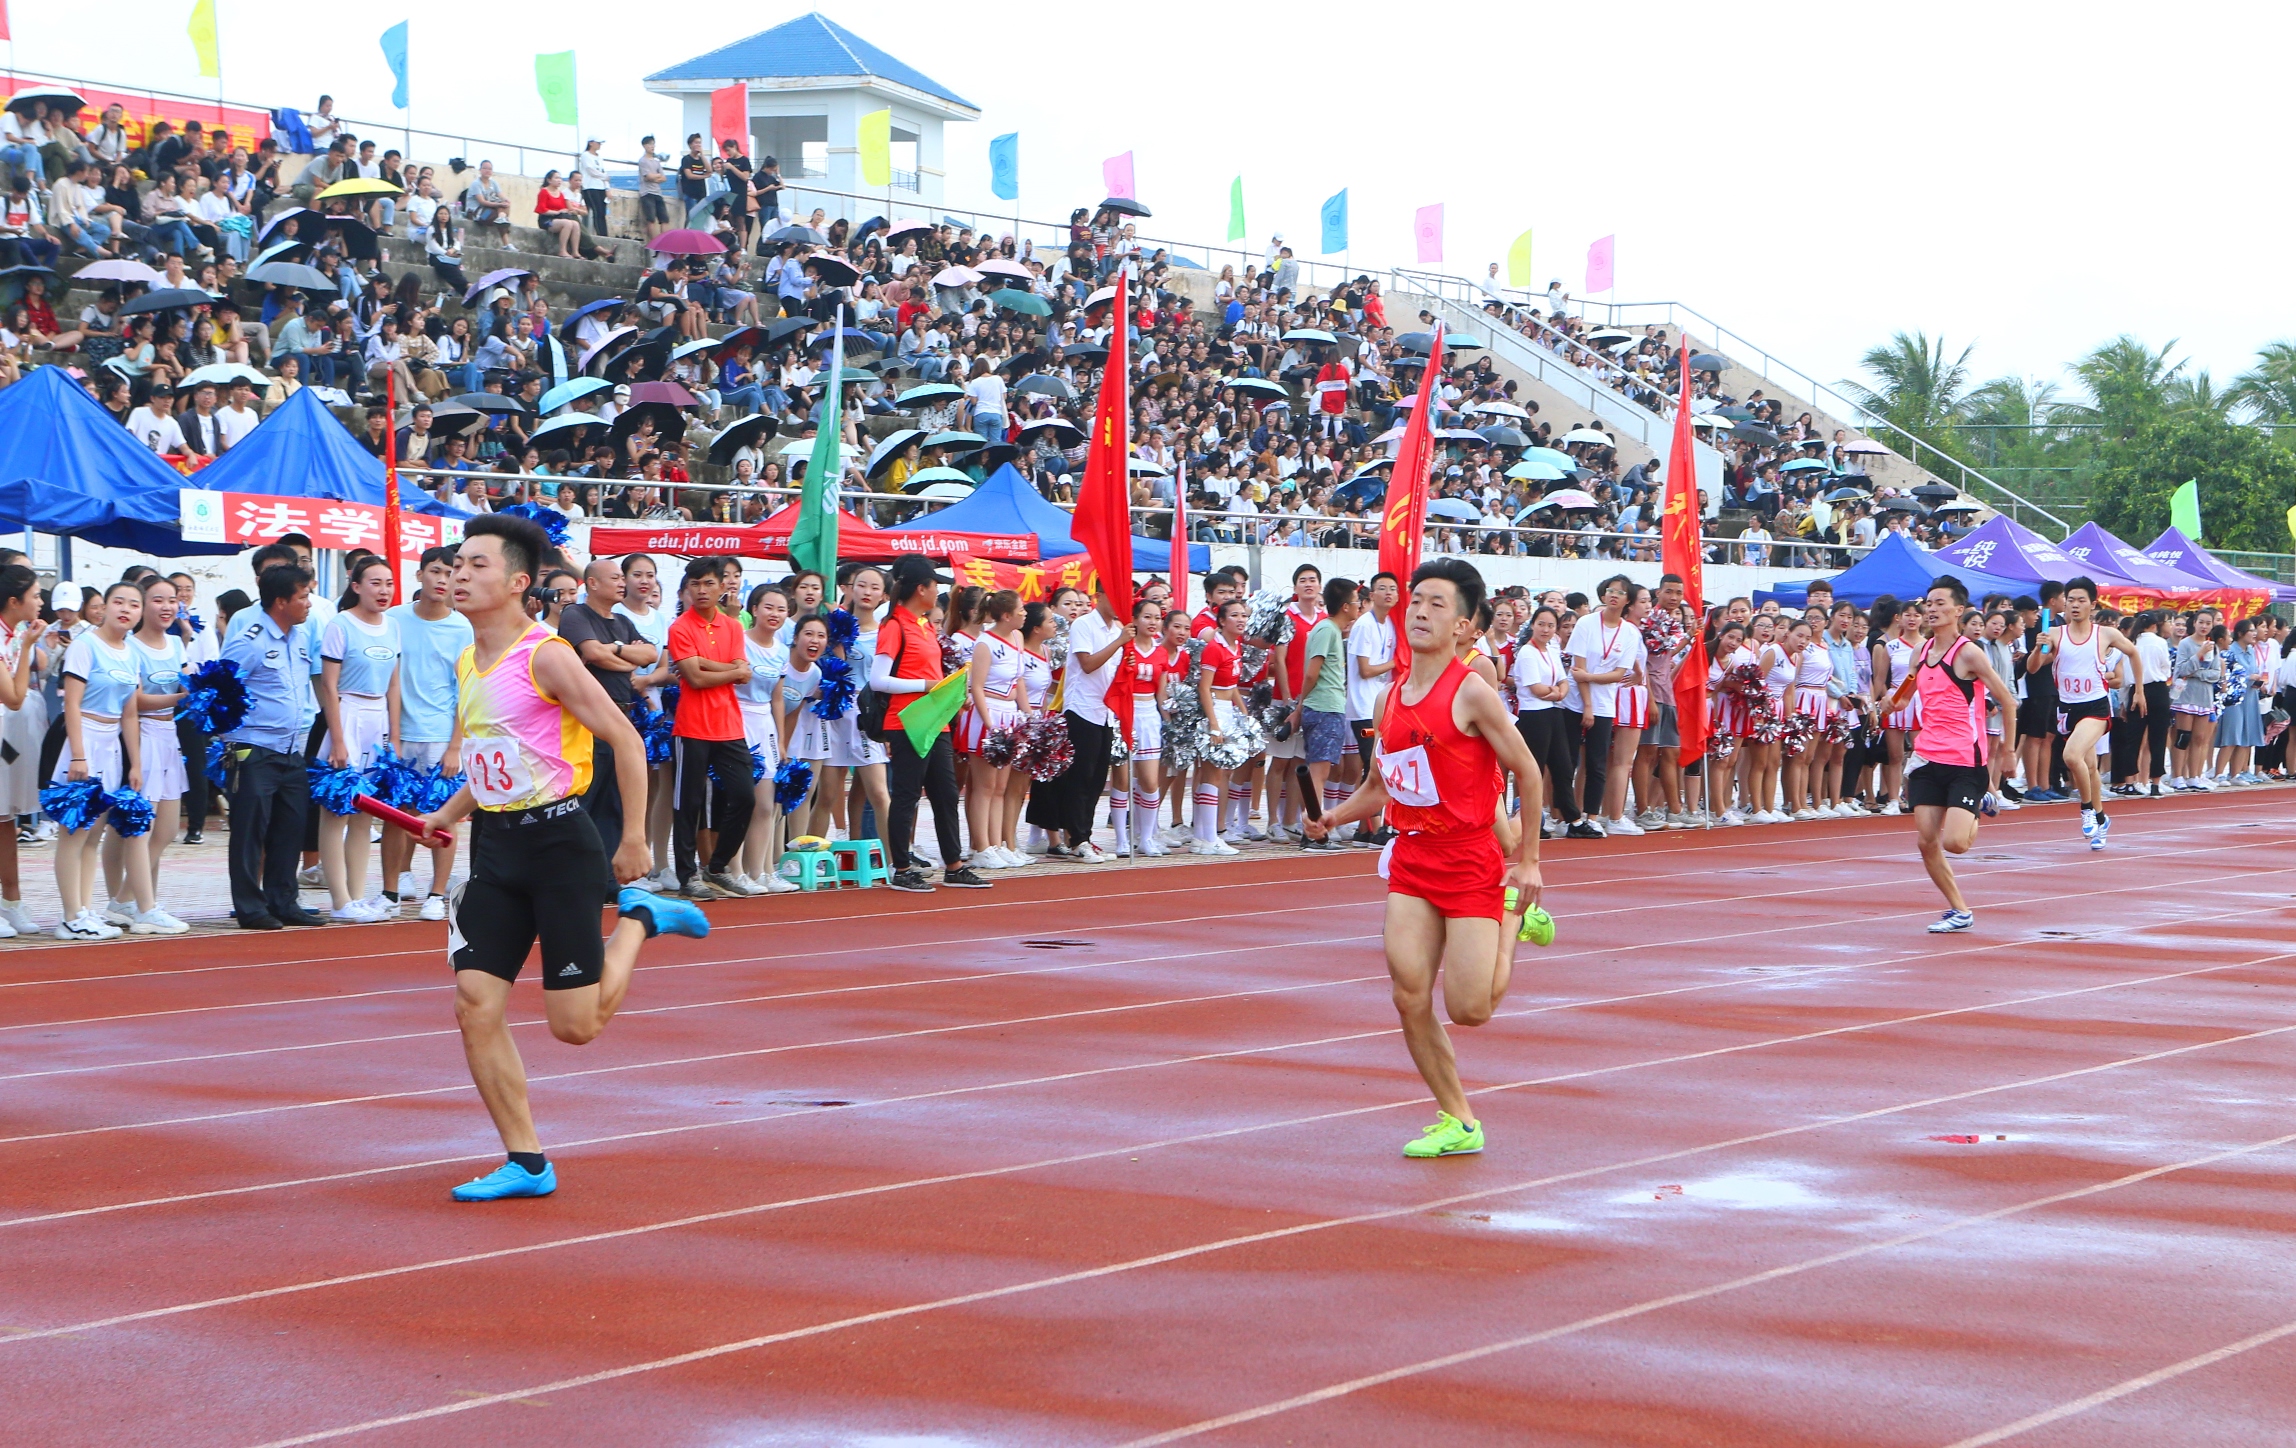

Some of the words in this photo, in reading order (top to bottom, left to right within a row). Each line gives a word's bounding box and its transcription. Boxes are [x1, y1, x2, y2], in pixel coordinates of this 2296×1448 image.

[648, 532, 741, 552] edu.jd.com
[890, 534, 969, 554] edu.jd.com
[2064, 678, 2092, 693] 030
